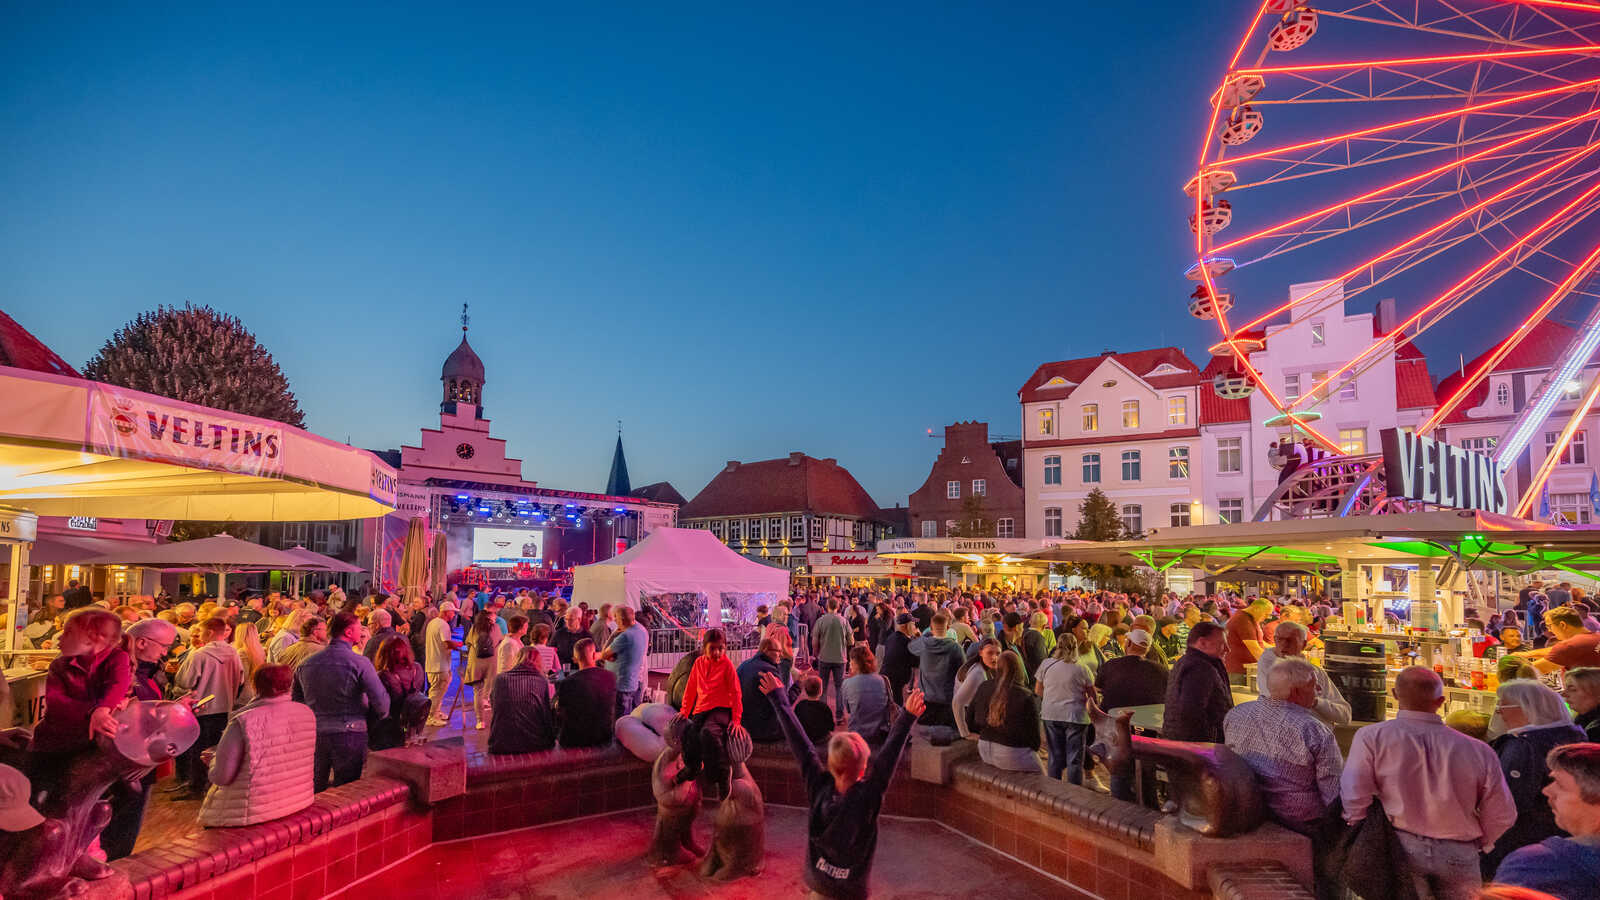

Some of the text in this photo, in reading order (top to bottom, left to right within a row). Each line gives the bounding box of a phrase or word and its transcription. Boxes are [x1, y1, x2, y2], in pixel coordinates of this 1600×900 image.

[146, 410, 279, 459] VELTINS
[375, 468, 397, 494] VELTINS
[1396, 427, 1508, 515] VELTINS
[963, 541, 996, 550] VELTINS
